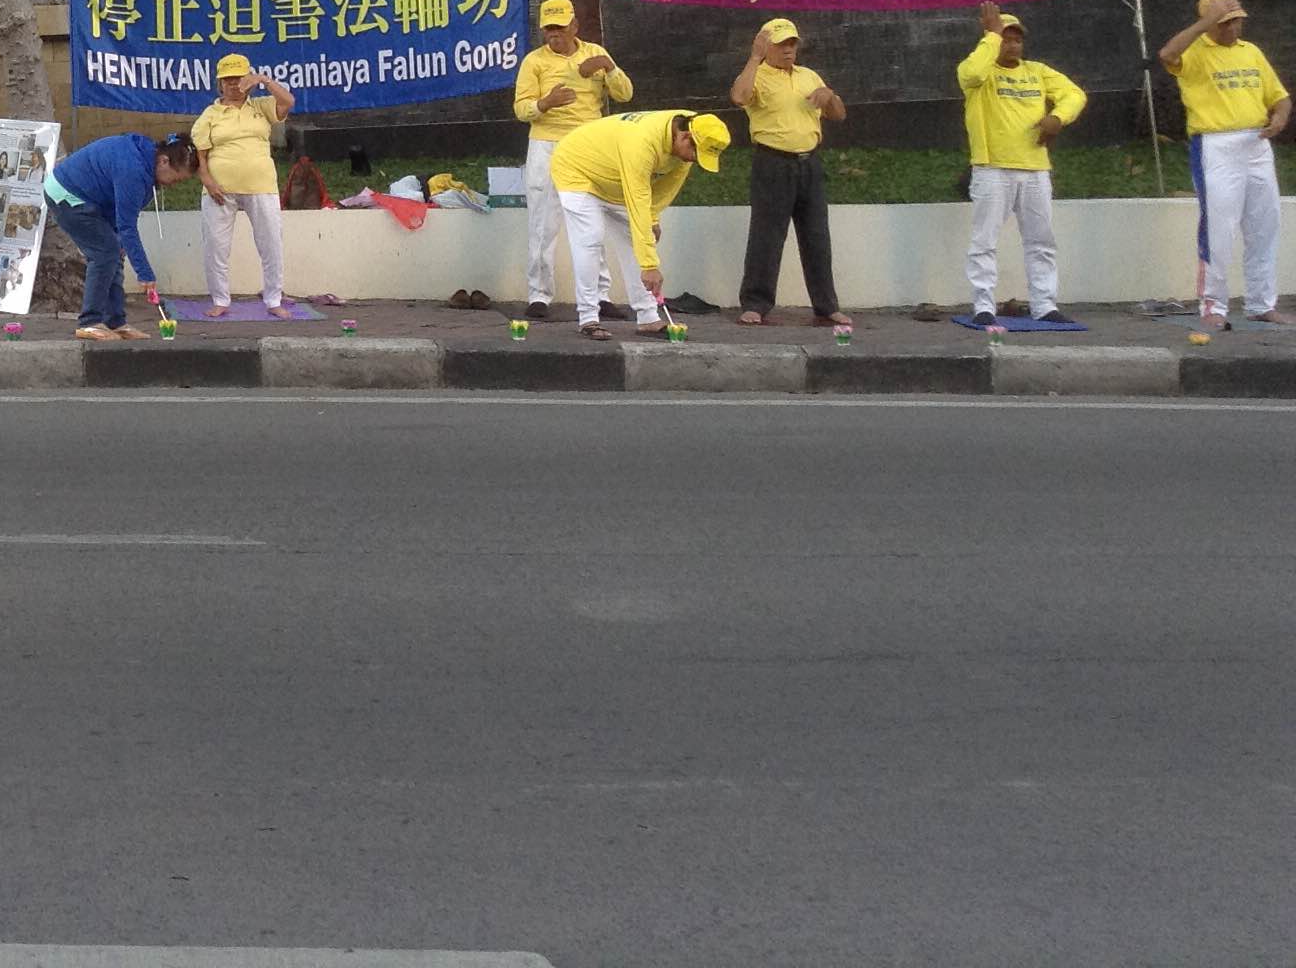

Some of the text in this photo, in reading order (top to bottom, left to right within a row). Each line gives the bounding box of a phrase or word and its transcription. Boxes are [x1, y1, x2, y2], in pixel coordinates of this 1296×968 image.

[87, 49, 211, 91] HENTIKAN
[378, 47, 446, 82] Falun
[454, 32, 518, 73] Gong
